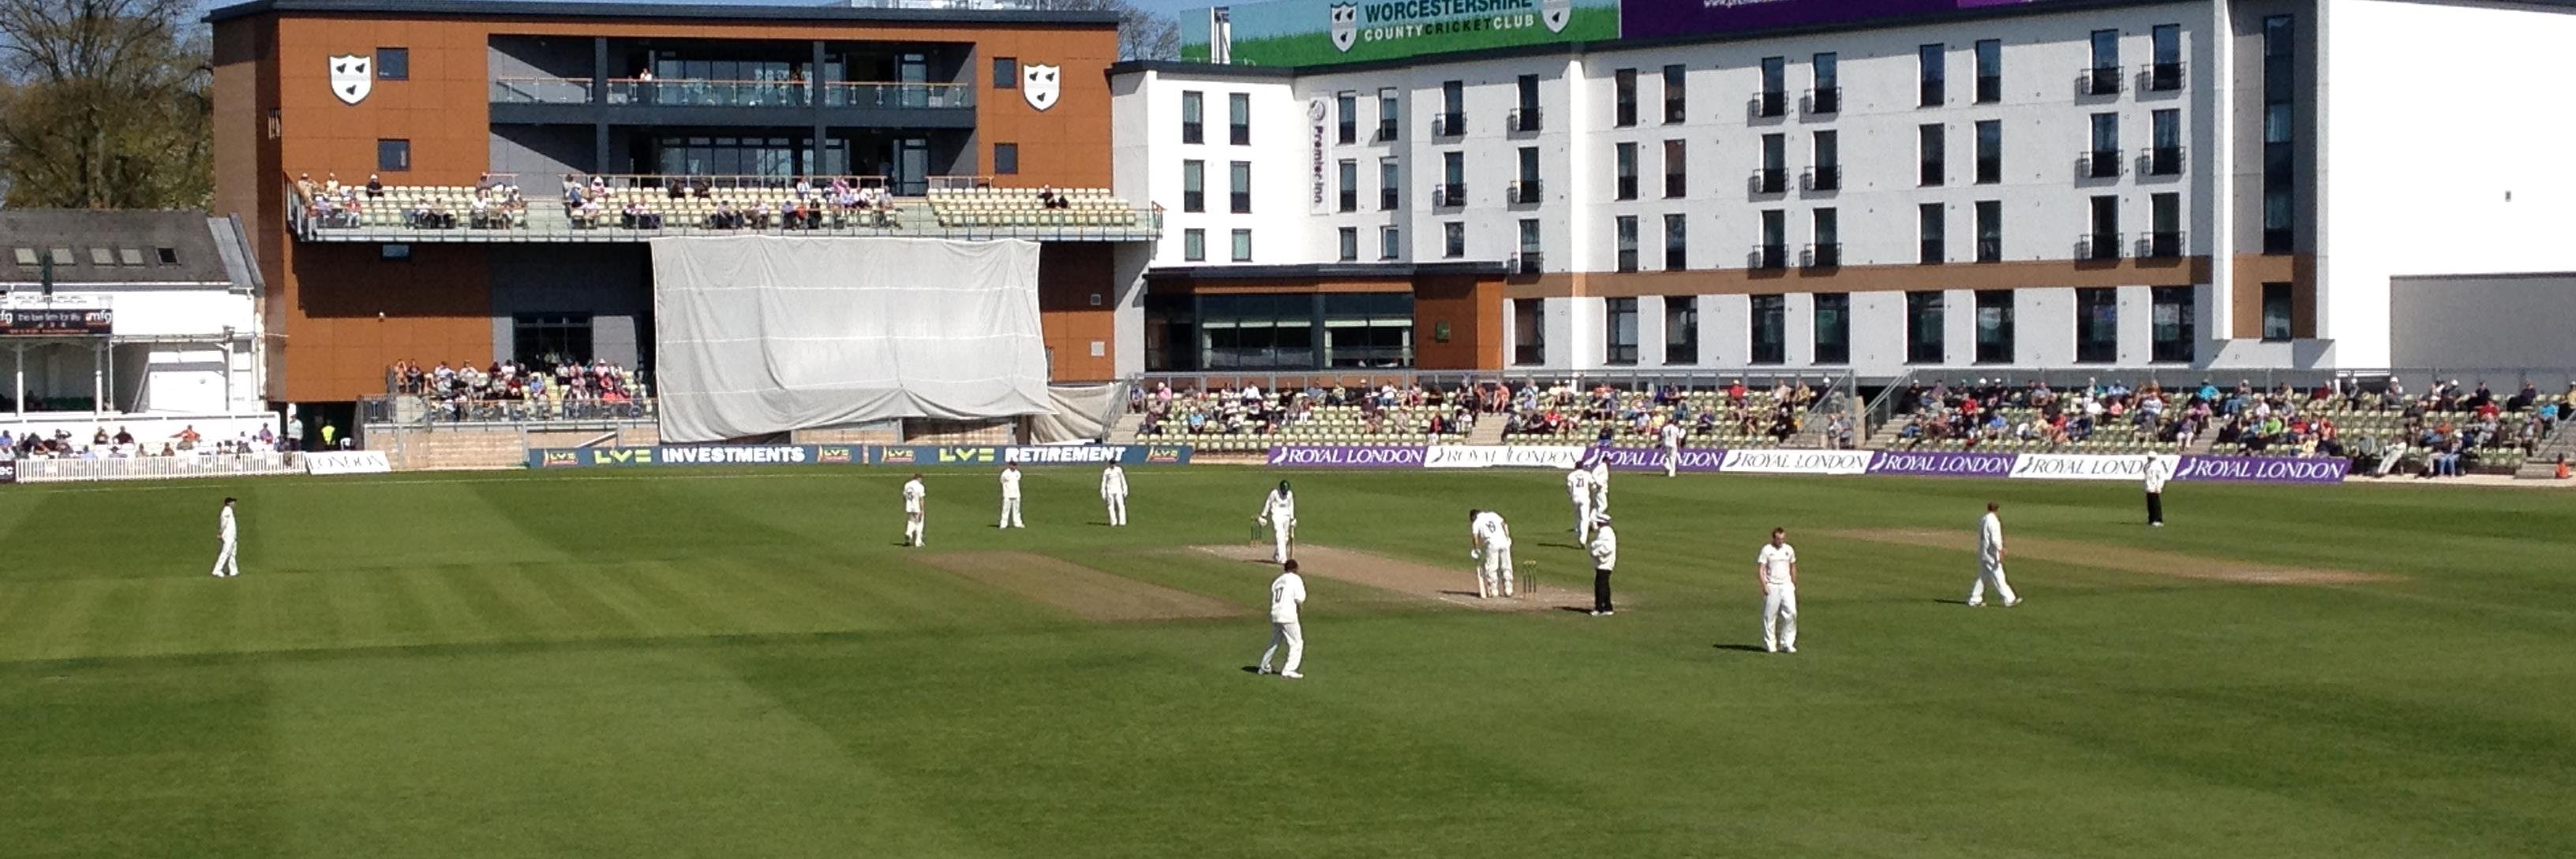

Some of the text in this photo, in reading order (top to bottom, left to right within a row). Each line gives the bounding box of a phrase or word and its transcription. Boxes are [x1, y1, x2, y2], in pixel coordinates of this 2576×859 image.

[1365, 14, 1533, 41] COUNTY CRICKET CLUB
[661, 447, 806, 463] INVESTMENTS
[1005, 447, 1126, 462] RETIREMENT
[1287, 449, 1424, 464] ROYAL LONDON
[1743, 454, 1866, 469] ROYAL LONDON
[1885, 455, 2013, 473] ROYAL LONDON
[2032, 458, 2084, 473] ROYAL
[2196, 460, 2345, 479] ROYAL LONDON
